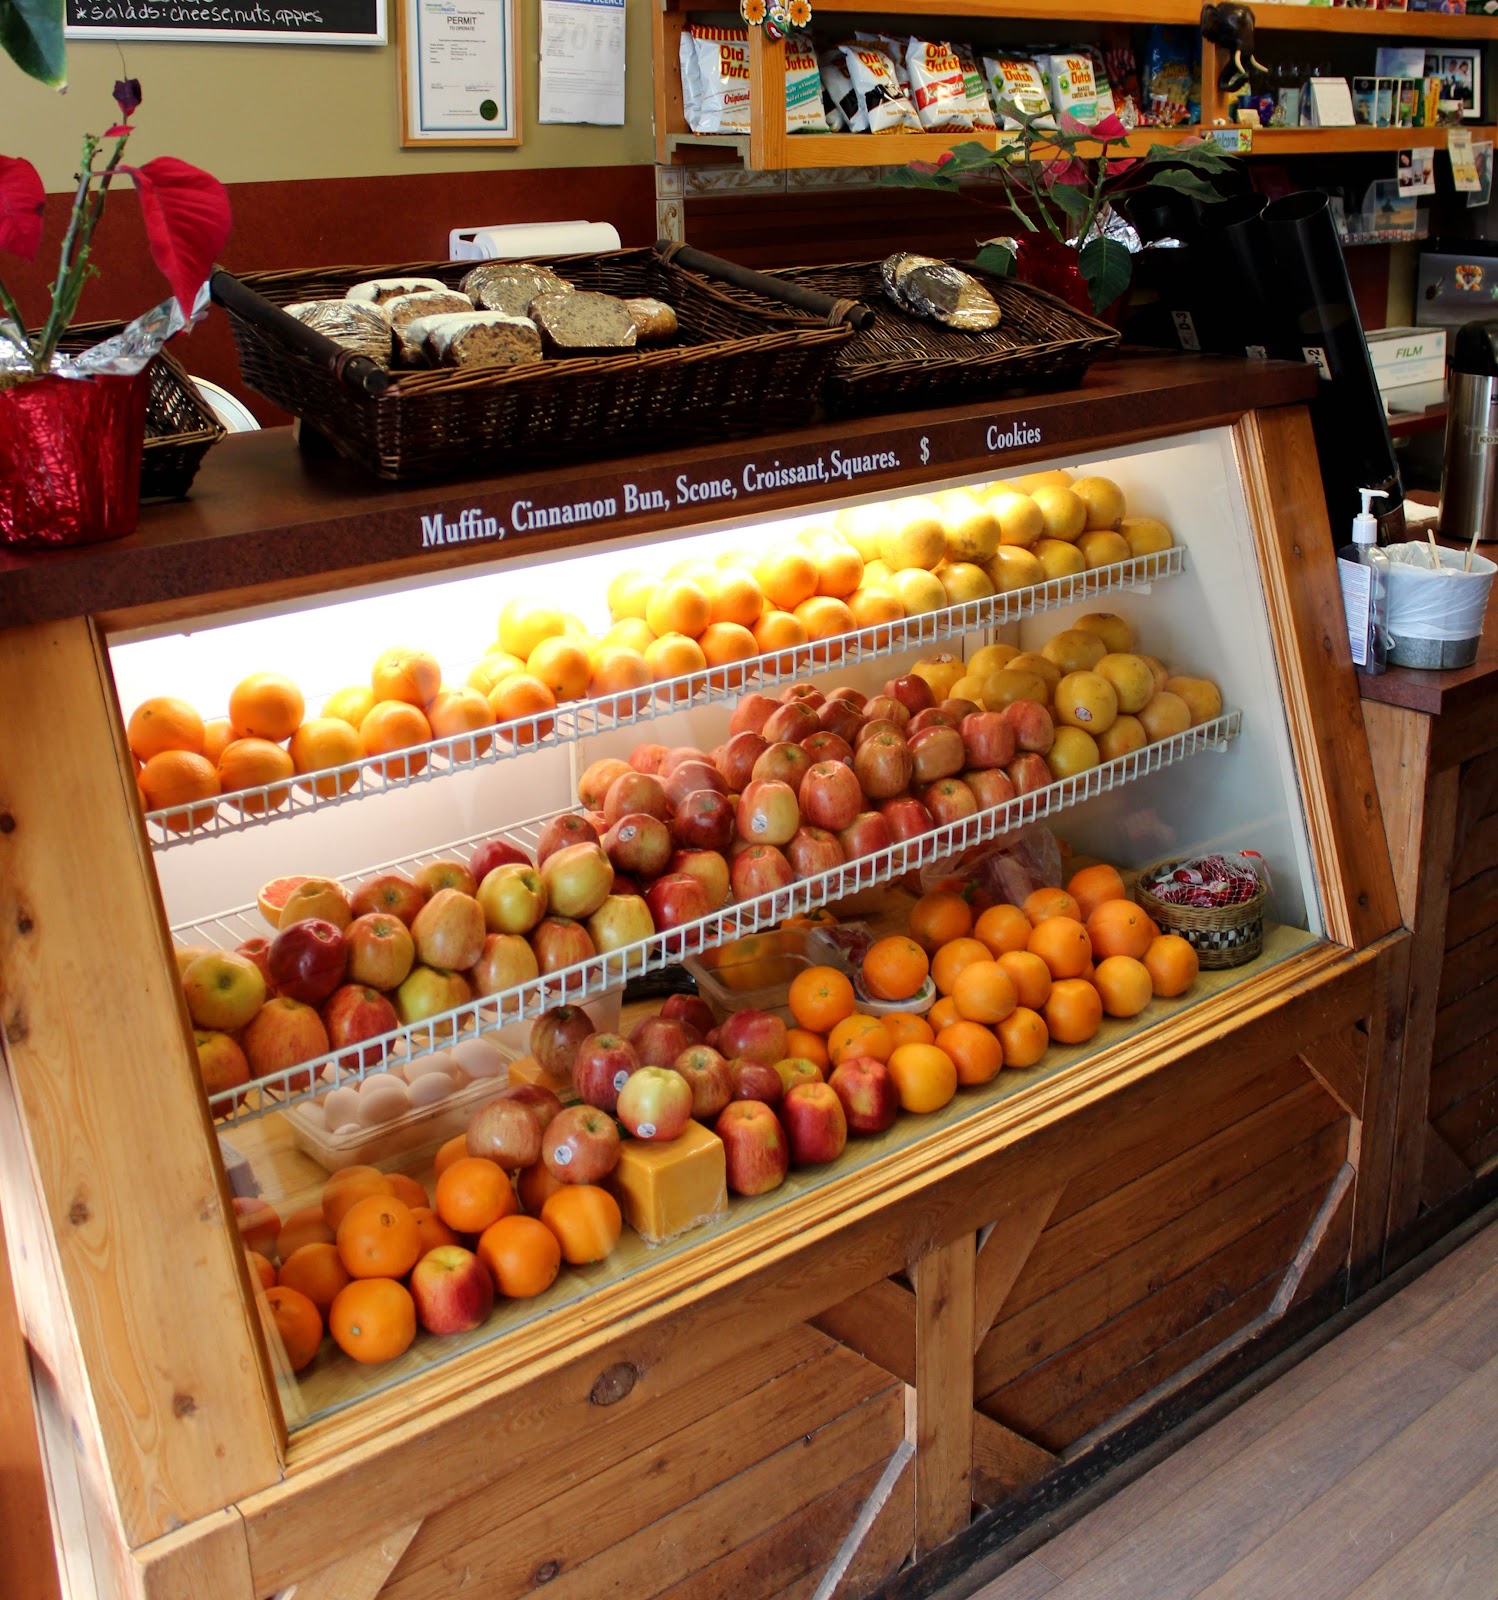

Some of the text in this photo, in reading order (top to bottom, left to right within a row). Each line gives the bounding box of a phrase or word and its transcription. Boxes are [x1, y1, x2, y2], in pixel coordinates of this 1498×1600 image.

[447, 16, 477, 25] PERMIT
[720, 44, 744, 61] Old
[926, 43, 948, 58] Old
[857, 51, 880, 65] Old
[926, 55, 960, 73] Dutch
[1067, 59, 1081, 70] Old
[720, 61, 750, 79] Dutc
[999, 61, 1018, 70] Old
[1003, 70, 1033, 82] Dutch
[1071, 70, 1091, 84] Dutch
[1395, 345, 1423, 358] FILM
[420, 509, 505, 547] Muffin,
[512, 498, 616, 532] Cinnamon
[623, 484, 670, 512] Bun,
[676, 474, 738, 503] Scone,
[920, 437, 930, 464] $
[986, 422, 1041, 450] Cookies
